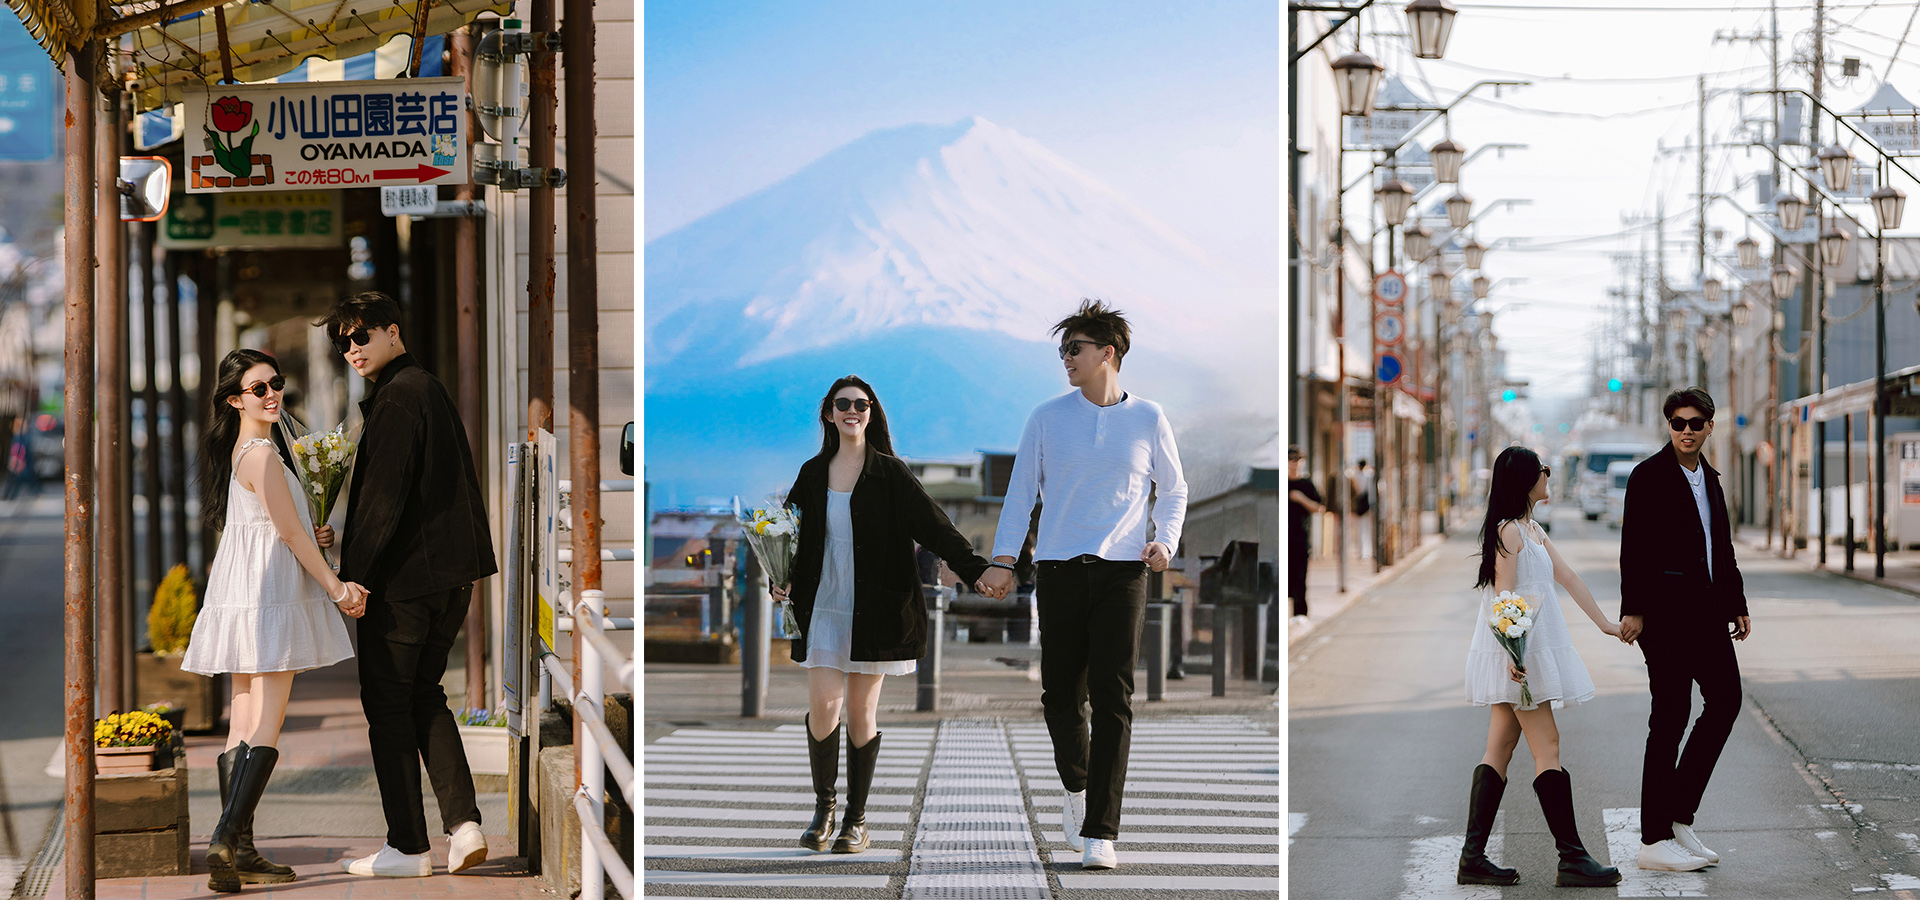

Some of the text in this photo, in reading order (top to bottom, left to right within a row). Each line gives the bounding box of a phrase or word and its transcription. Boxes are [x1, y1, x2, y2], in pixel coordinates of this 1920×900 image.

[267, 91, 458, 140] 小山田園芸店
[300, 140, 428, 162] OYAMADA
